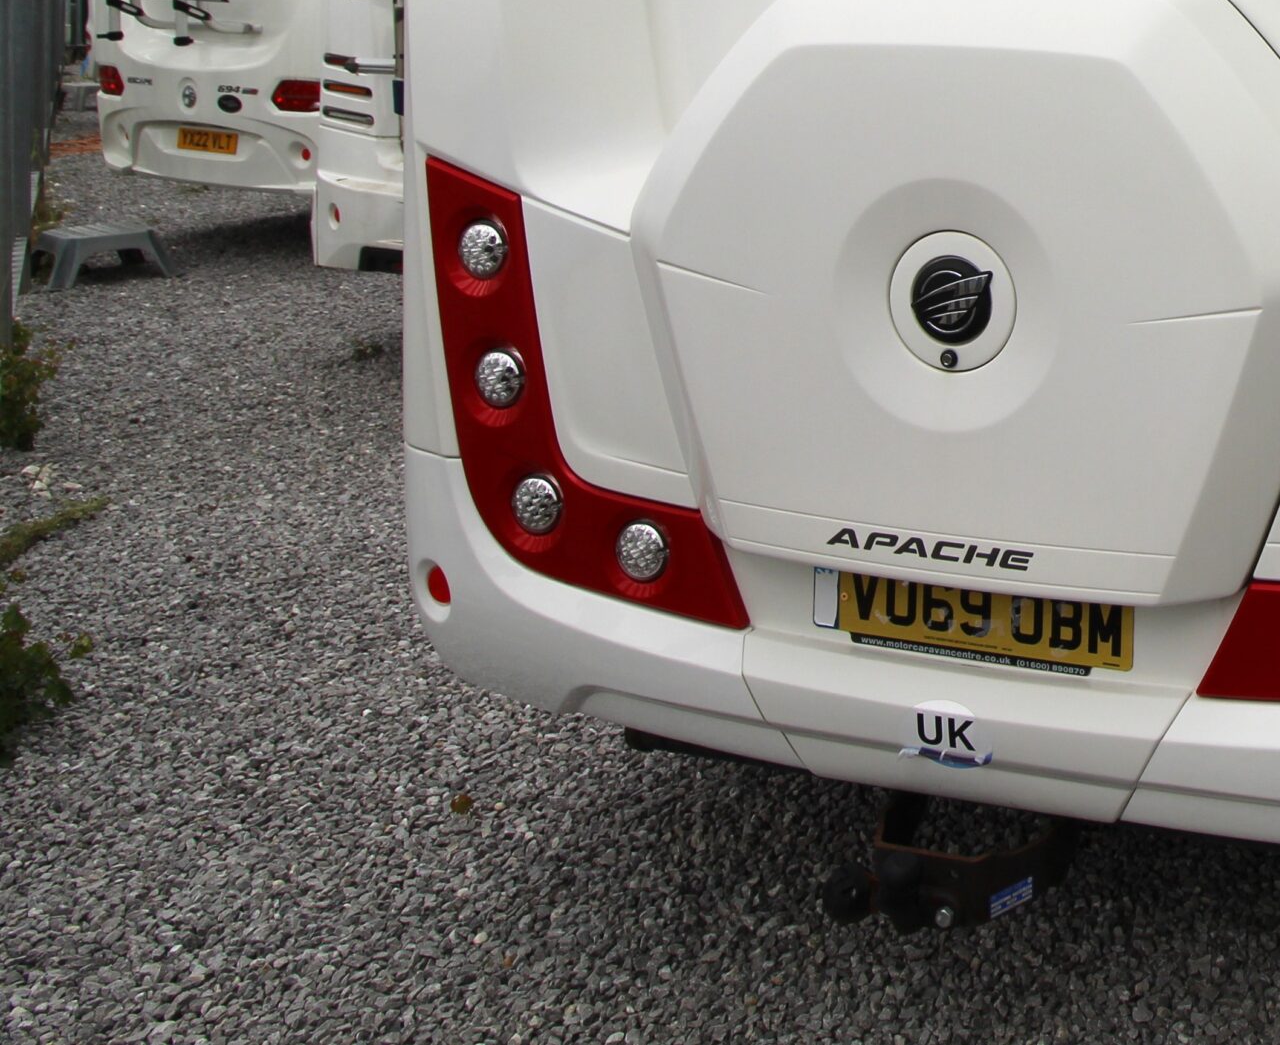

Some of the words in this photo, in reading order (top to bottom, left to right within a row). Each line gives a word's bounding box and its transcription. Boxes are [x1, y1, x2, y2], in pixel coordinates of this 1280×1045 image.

[217, 85, 240, 94] 694
[211, 131, 233, 151] VLT
[826, 527, 1034, 572] APACHE
[852, 573, 992, 638] VU69
[860, 636, 1011, 665] www.motorcaravancentre.co.uk
[1016, 659, 1050, 672] (01600)
[916, 712, 976, 752] UK
